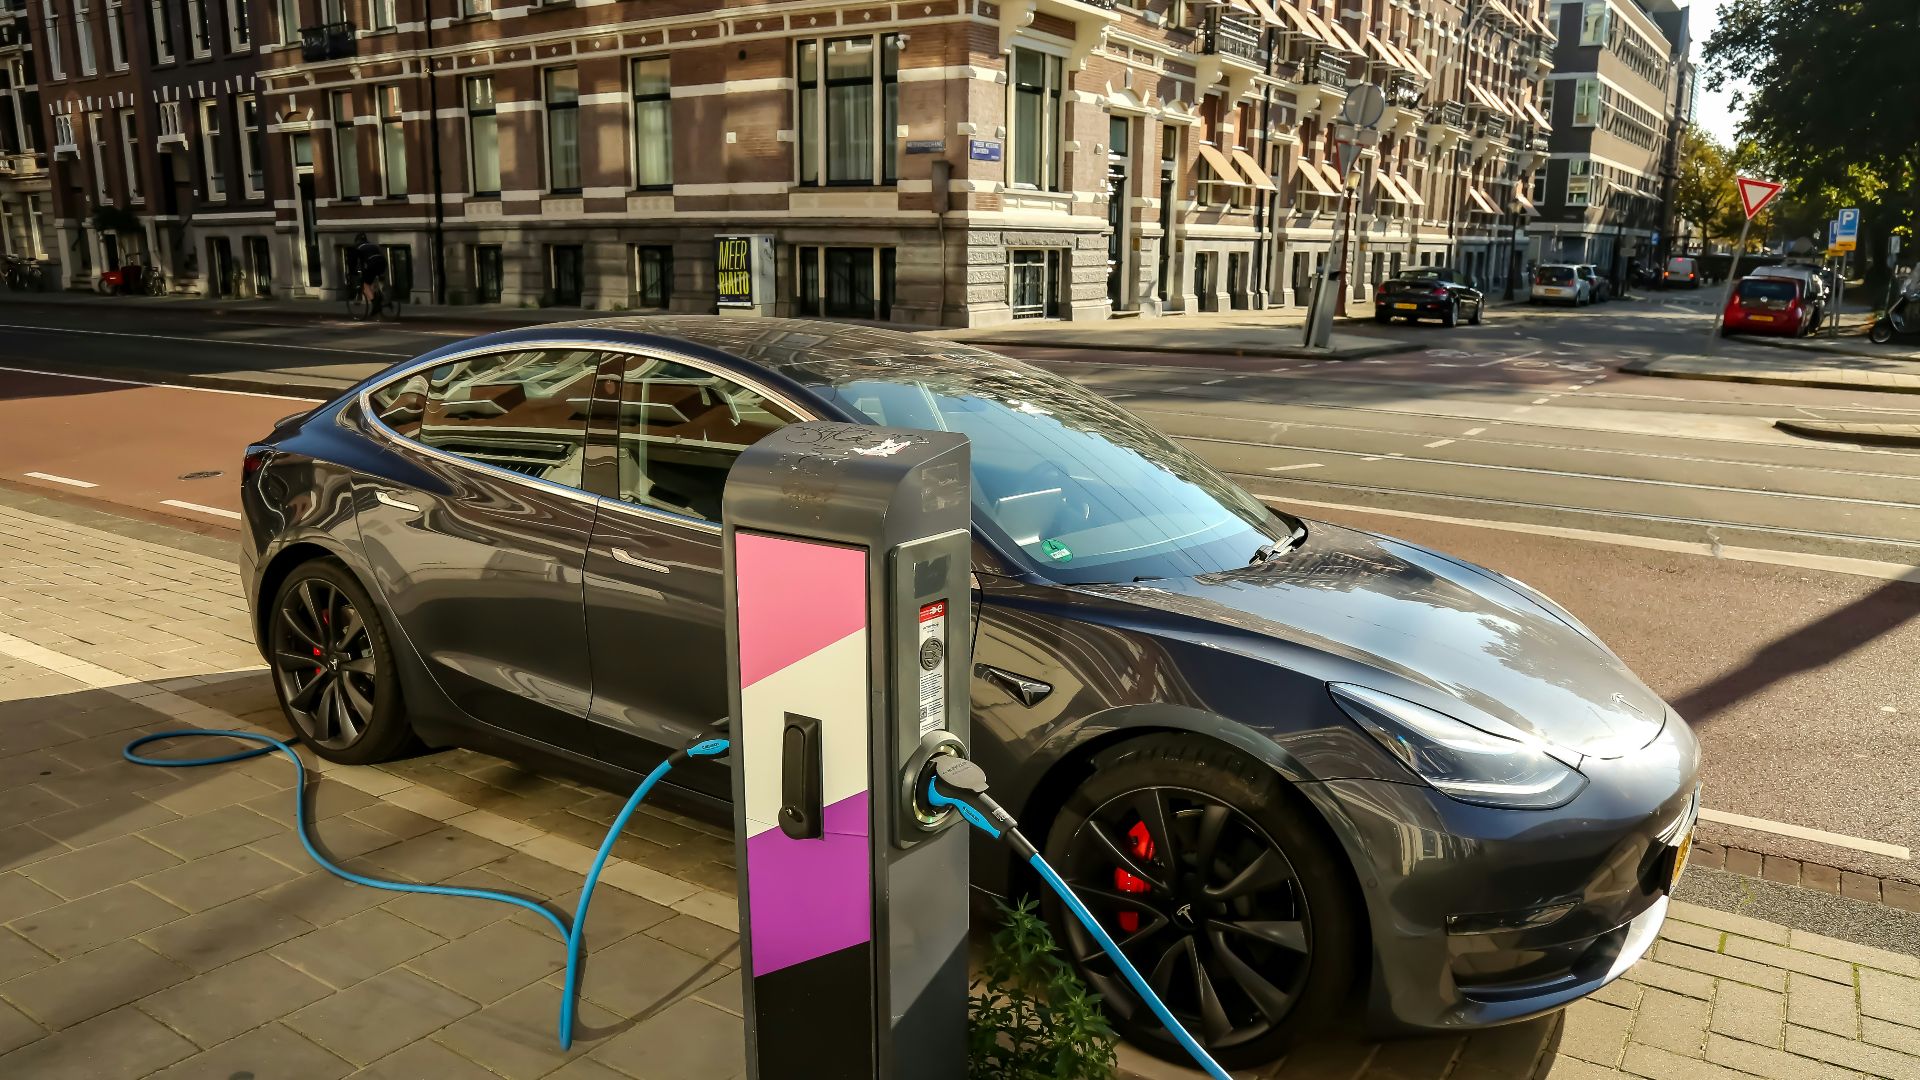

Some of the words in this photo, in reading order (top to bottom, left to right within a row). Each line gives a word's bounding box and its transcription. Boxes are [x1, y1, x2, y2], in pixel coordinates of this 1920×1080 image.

[1842, 211, 1854, 225] P
[718, 240, 747, 270] MEER
[719, 271, 749, 295] RIALTO
